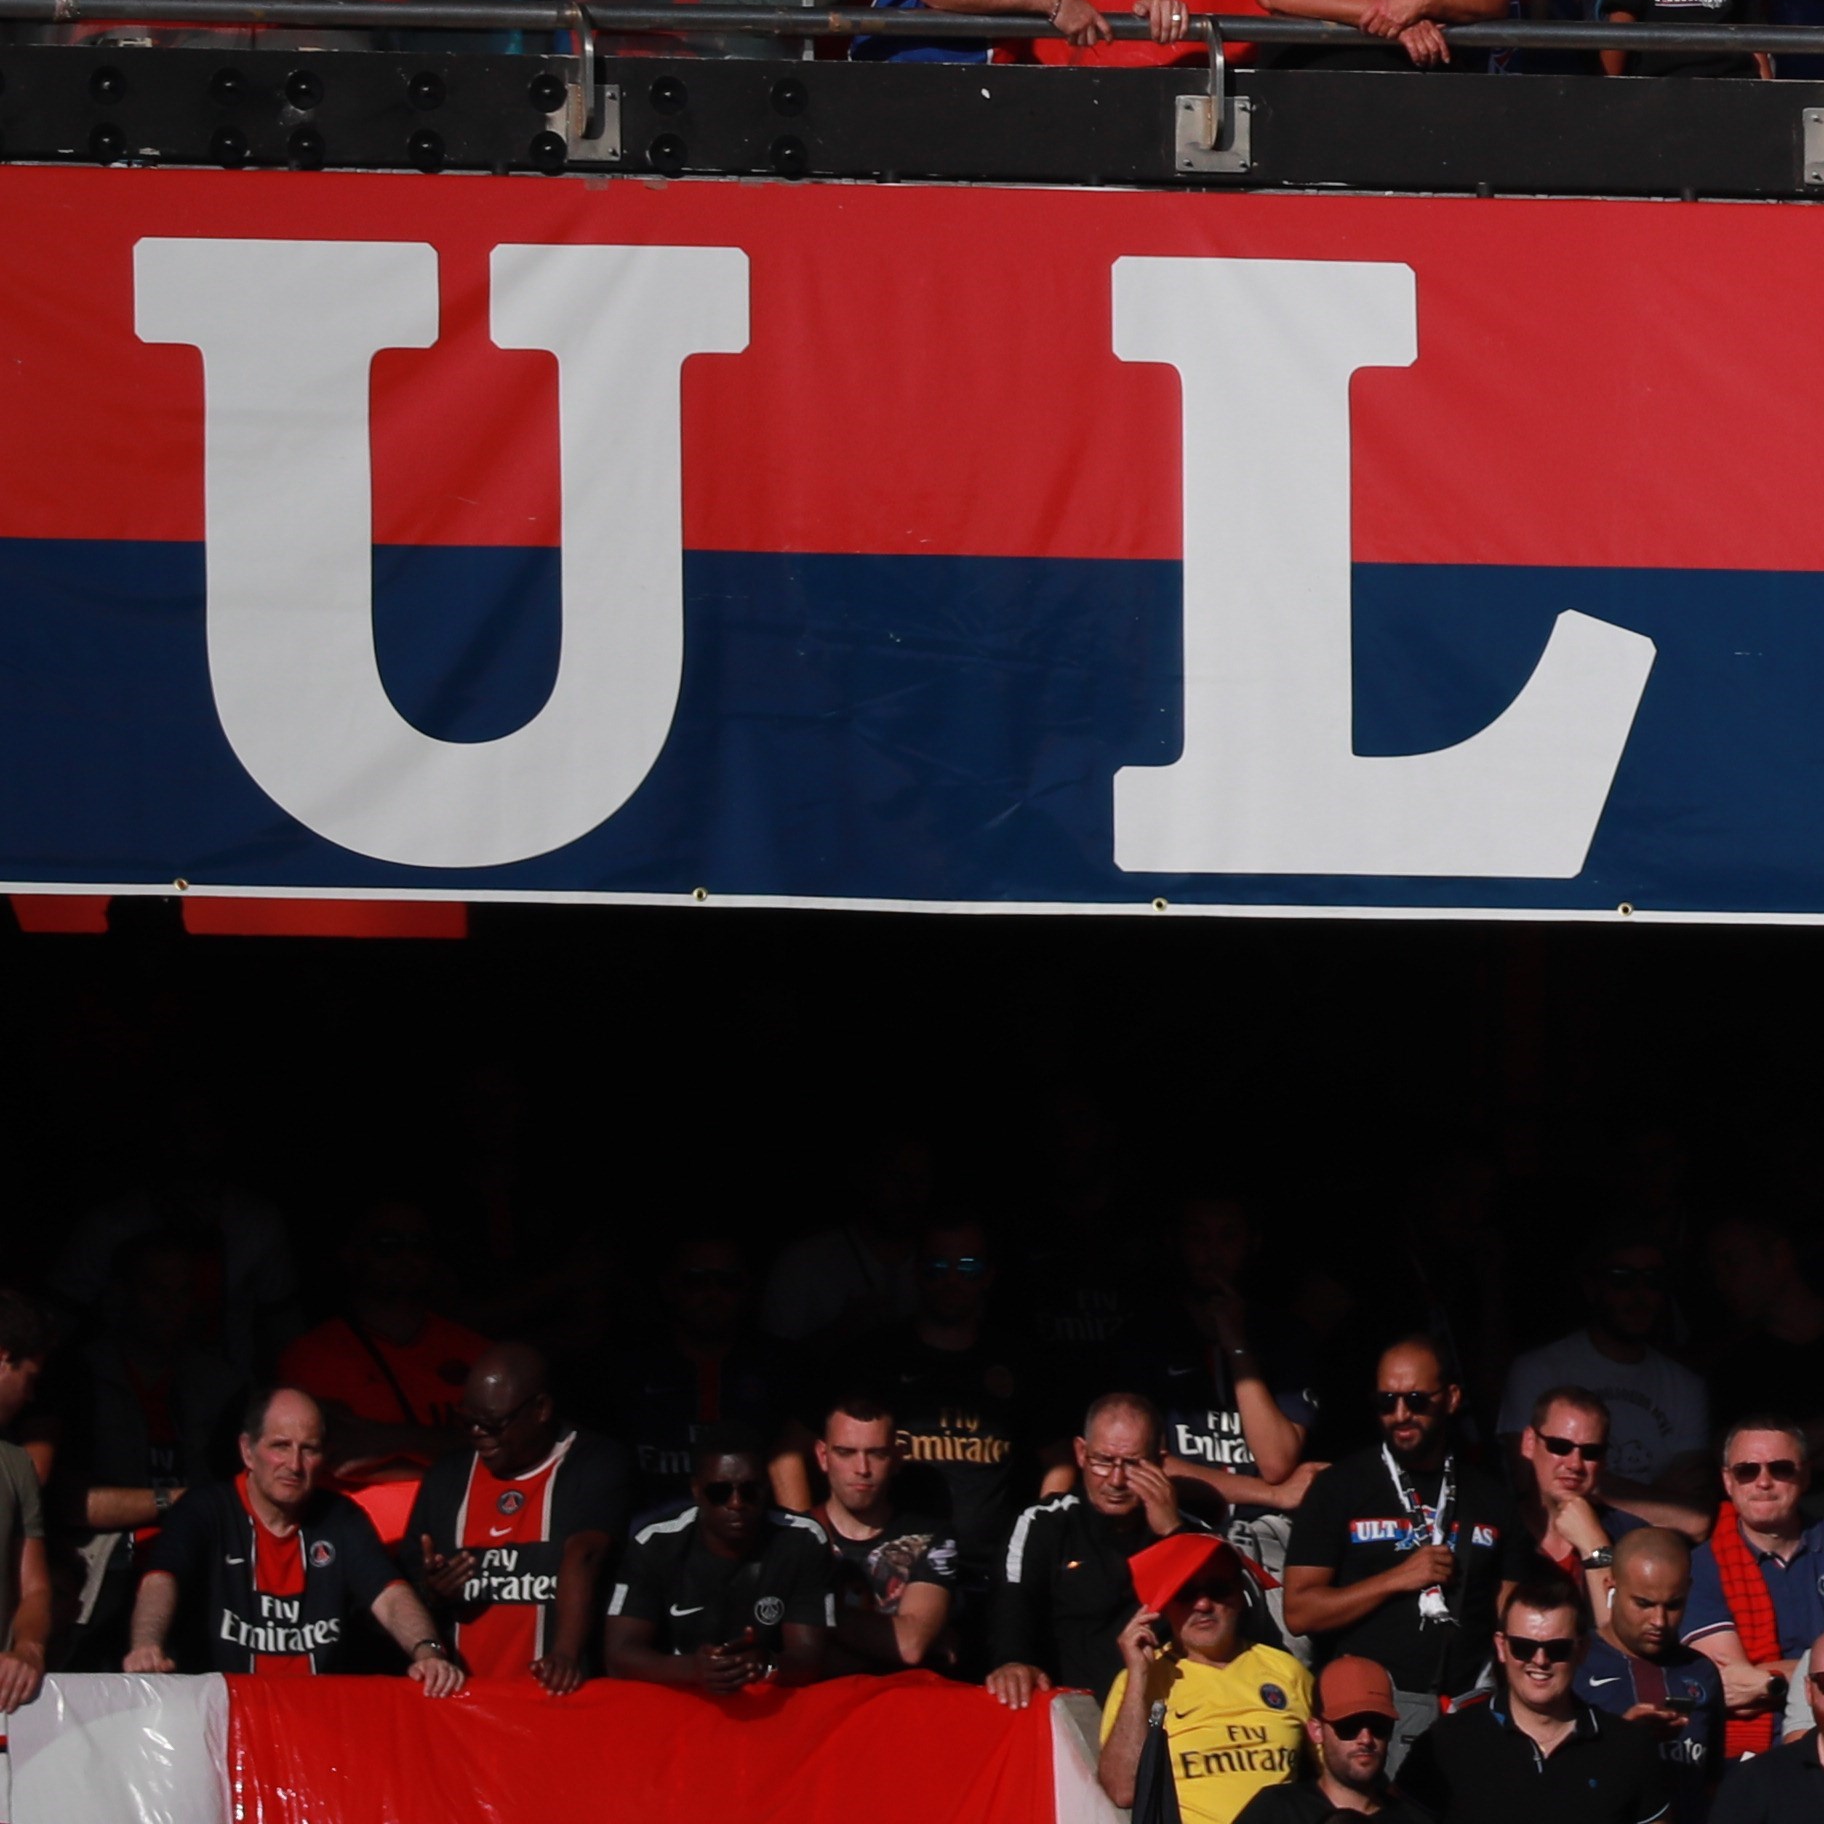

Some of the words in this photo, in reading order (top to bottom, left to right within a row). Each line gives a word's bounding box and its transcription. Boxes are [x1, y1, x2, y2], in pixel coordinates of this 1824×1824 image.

[1206, 1410, 1241, 1436] Fly
[1354, 1521, 1399, 1541] ULT
[1470, 1526, 1495, 1547] AS
[261, 1594, 302, 1624] Fly
[220, 1607, 343, 1653] Emirates
[1225, 1725, 1268, 1753] Fly
